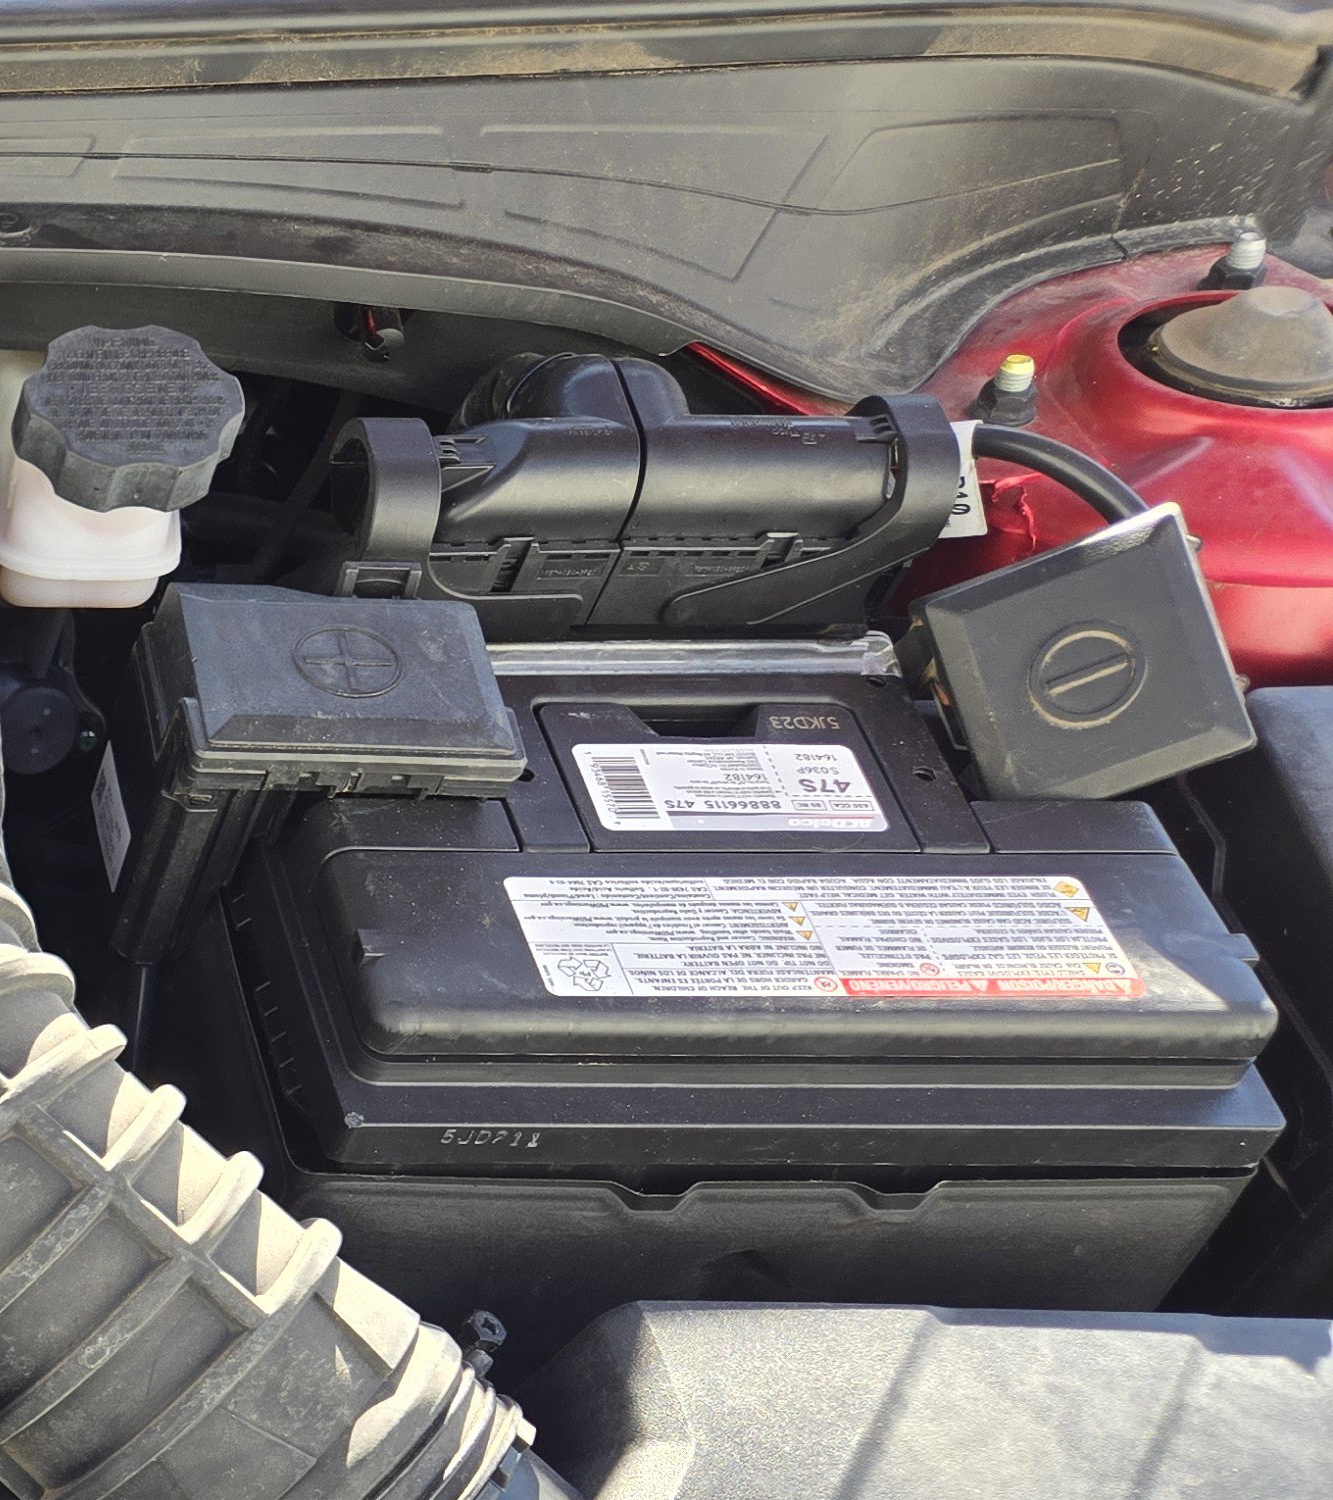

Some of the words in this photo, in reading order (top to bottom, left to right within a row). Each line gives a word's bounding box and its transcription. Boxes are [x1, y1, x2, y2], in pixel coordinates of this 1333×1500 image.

[769, 715, 840, 730] 5JKD23
[794, 753, 837, 761] 164182
[723, 773, 767, 781] 164182
[798, 778, 851, 793] 47S
[663, 799, 696, 809] 47S
[703, 800, 782, 810] 88866115
